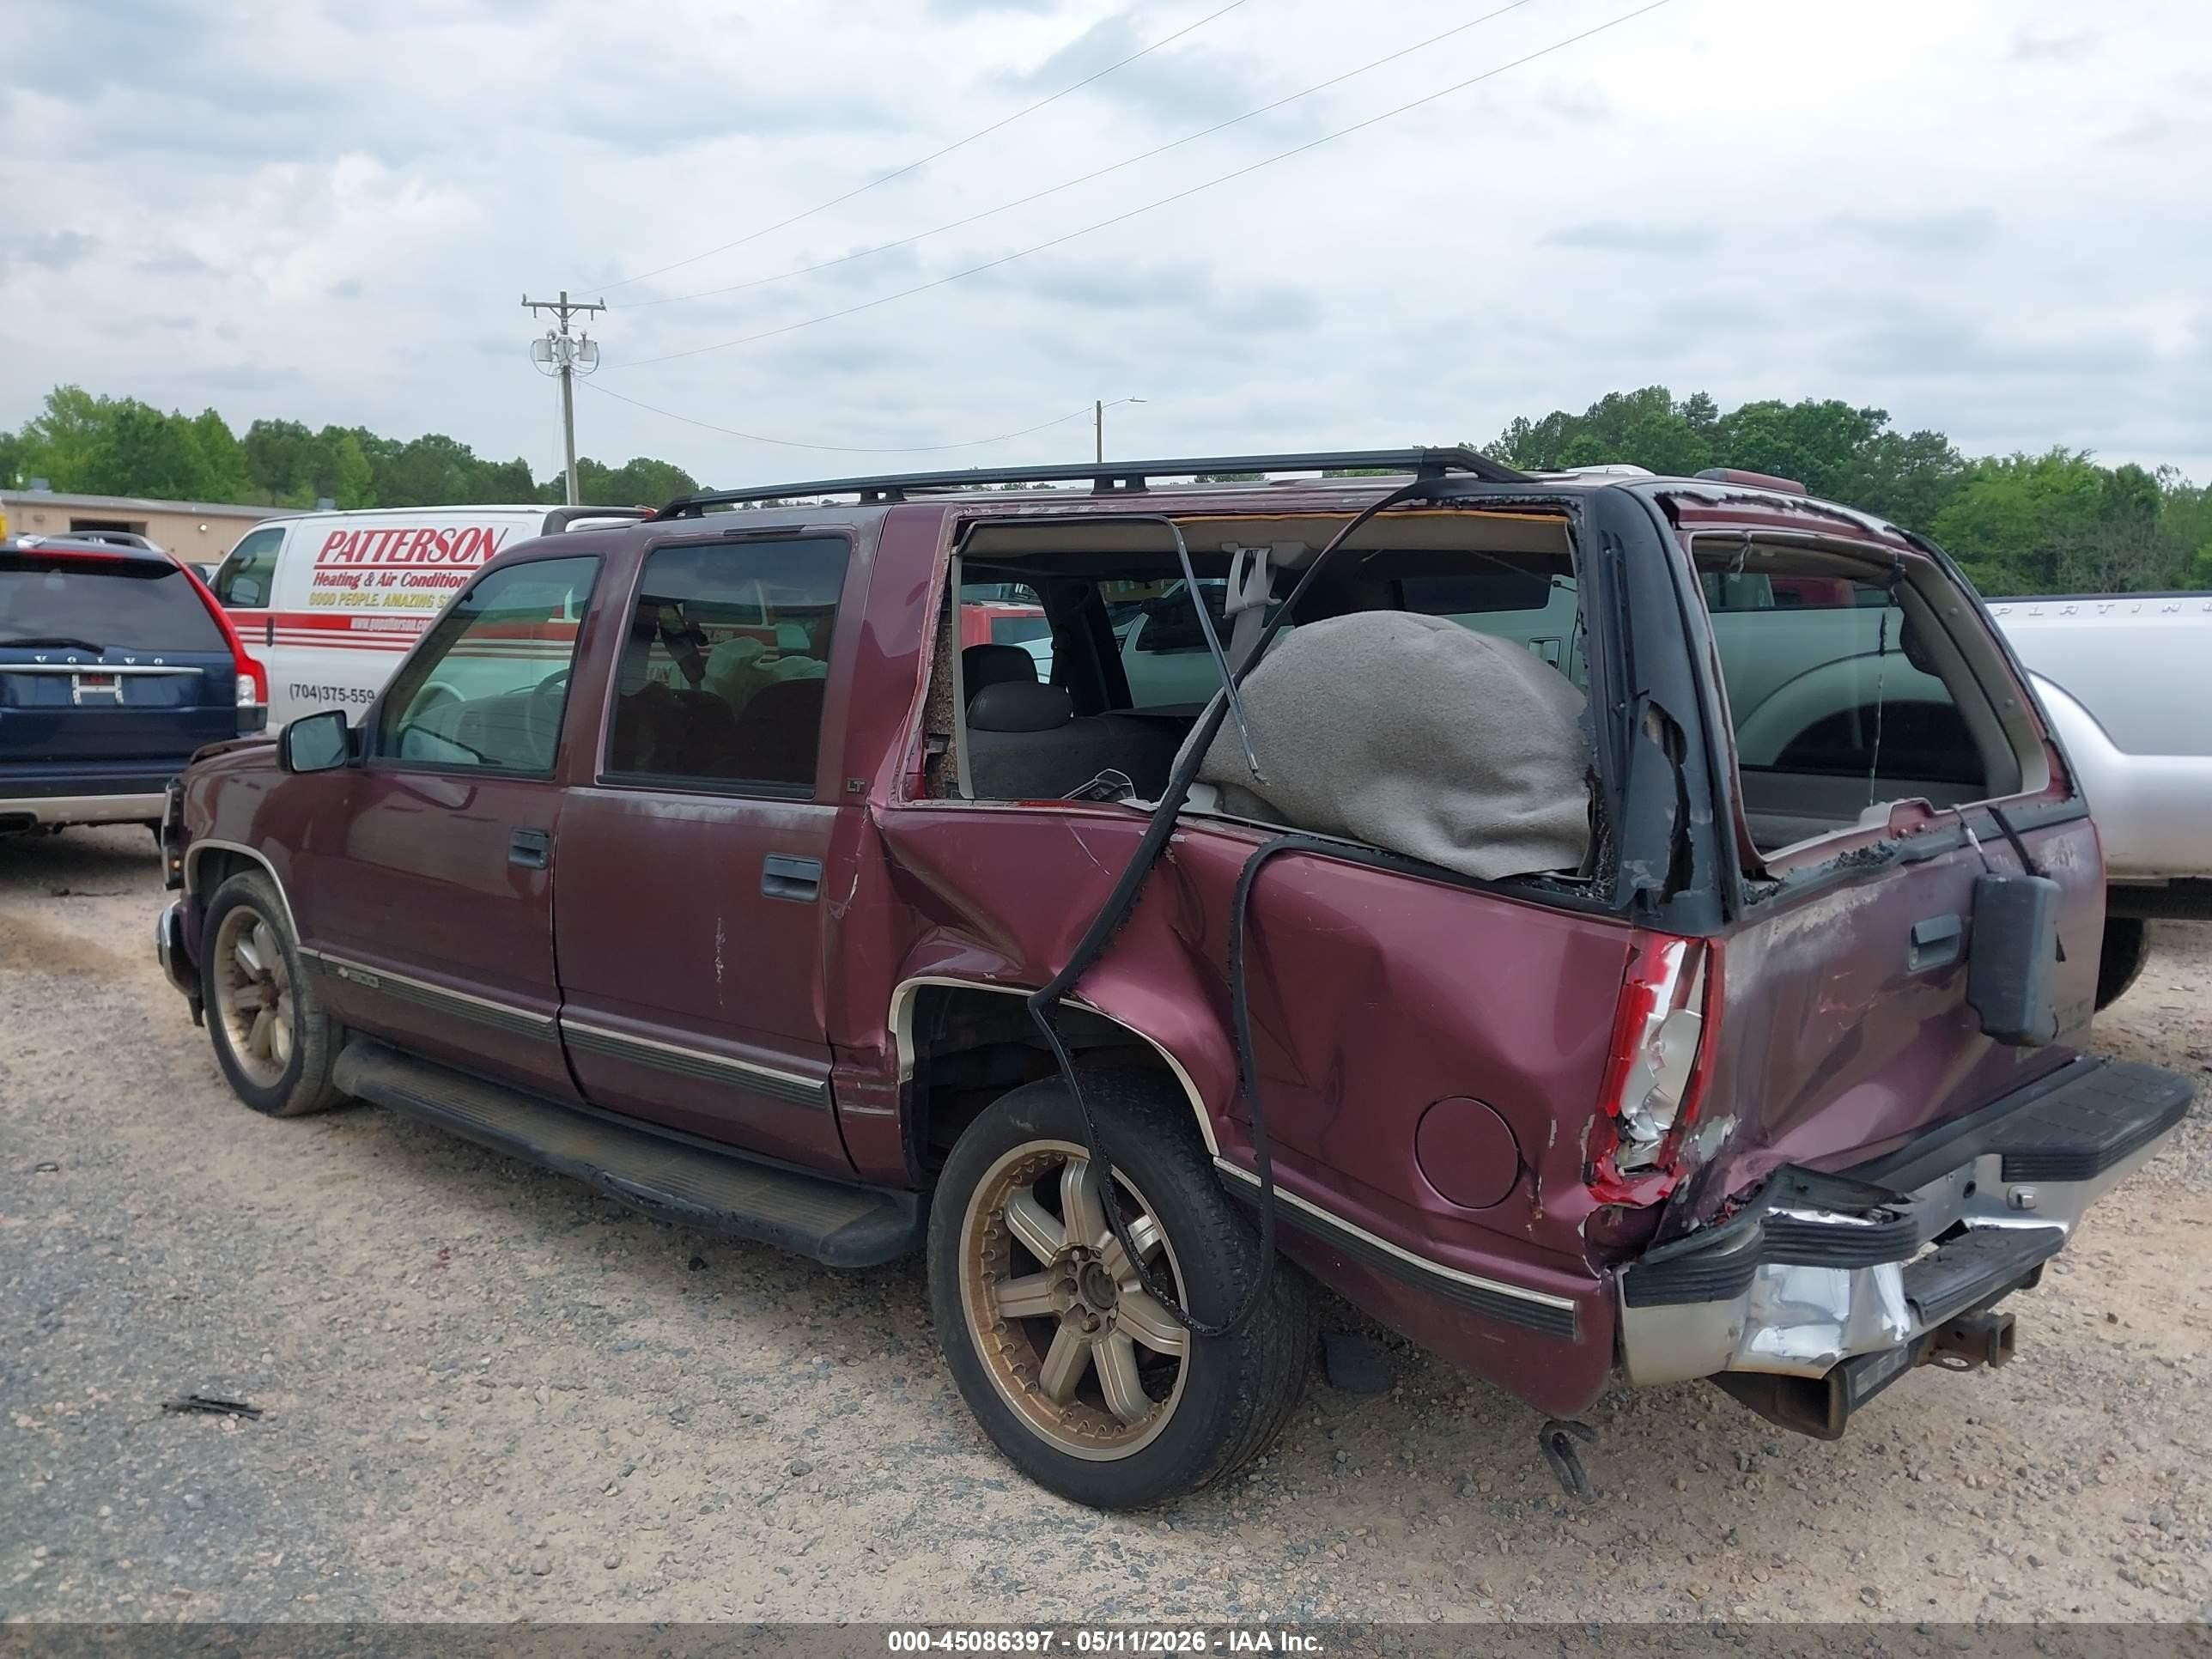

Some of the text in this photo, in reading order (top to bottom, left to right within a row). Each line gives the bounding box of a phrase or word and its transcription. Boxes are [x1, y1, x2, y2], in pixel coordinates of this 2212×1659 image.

[316, 527, 508, 562] PATTERSON
[313, 572, 472, 590] Heating & Air Condition
[310, 592, 336, 607] GOOD
[382, 594, 435, 609] AMAZING
[34, 655, 163, 665] VOLVO
[847, 780, 866, 793] LT
